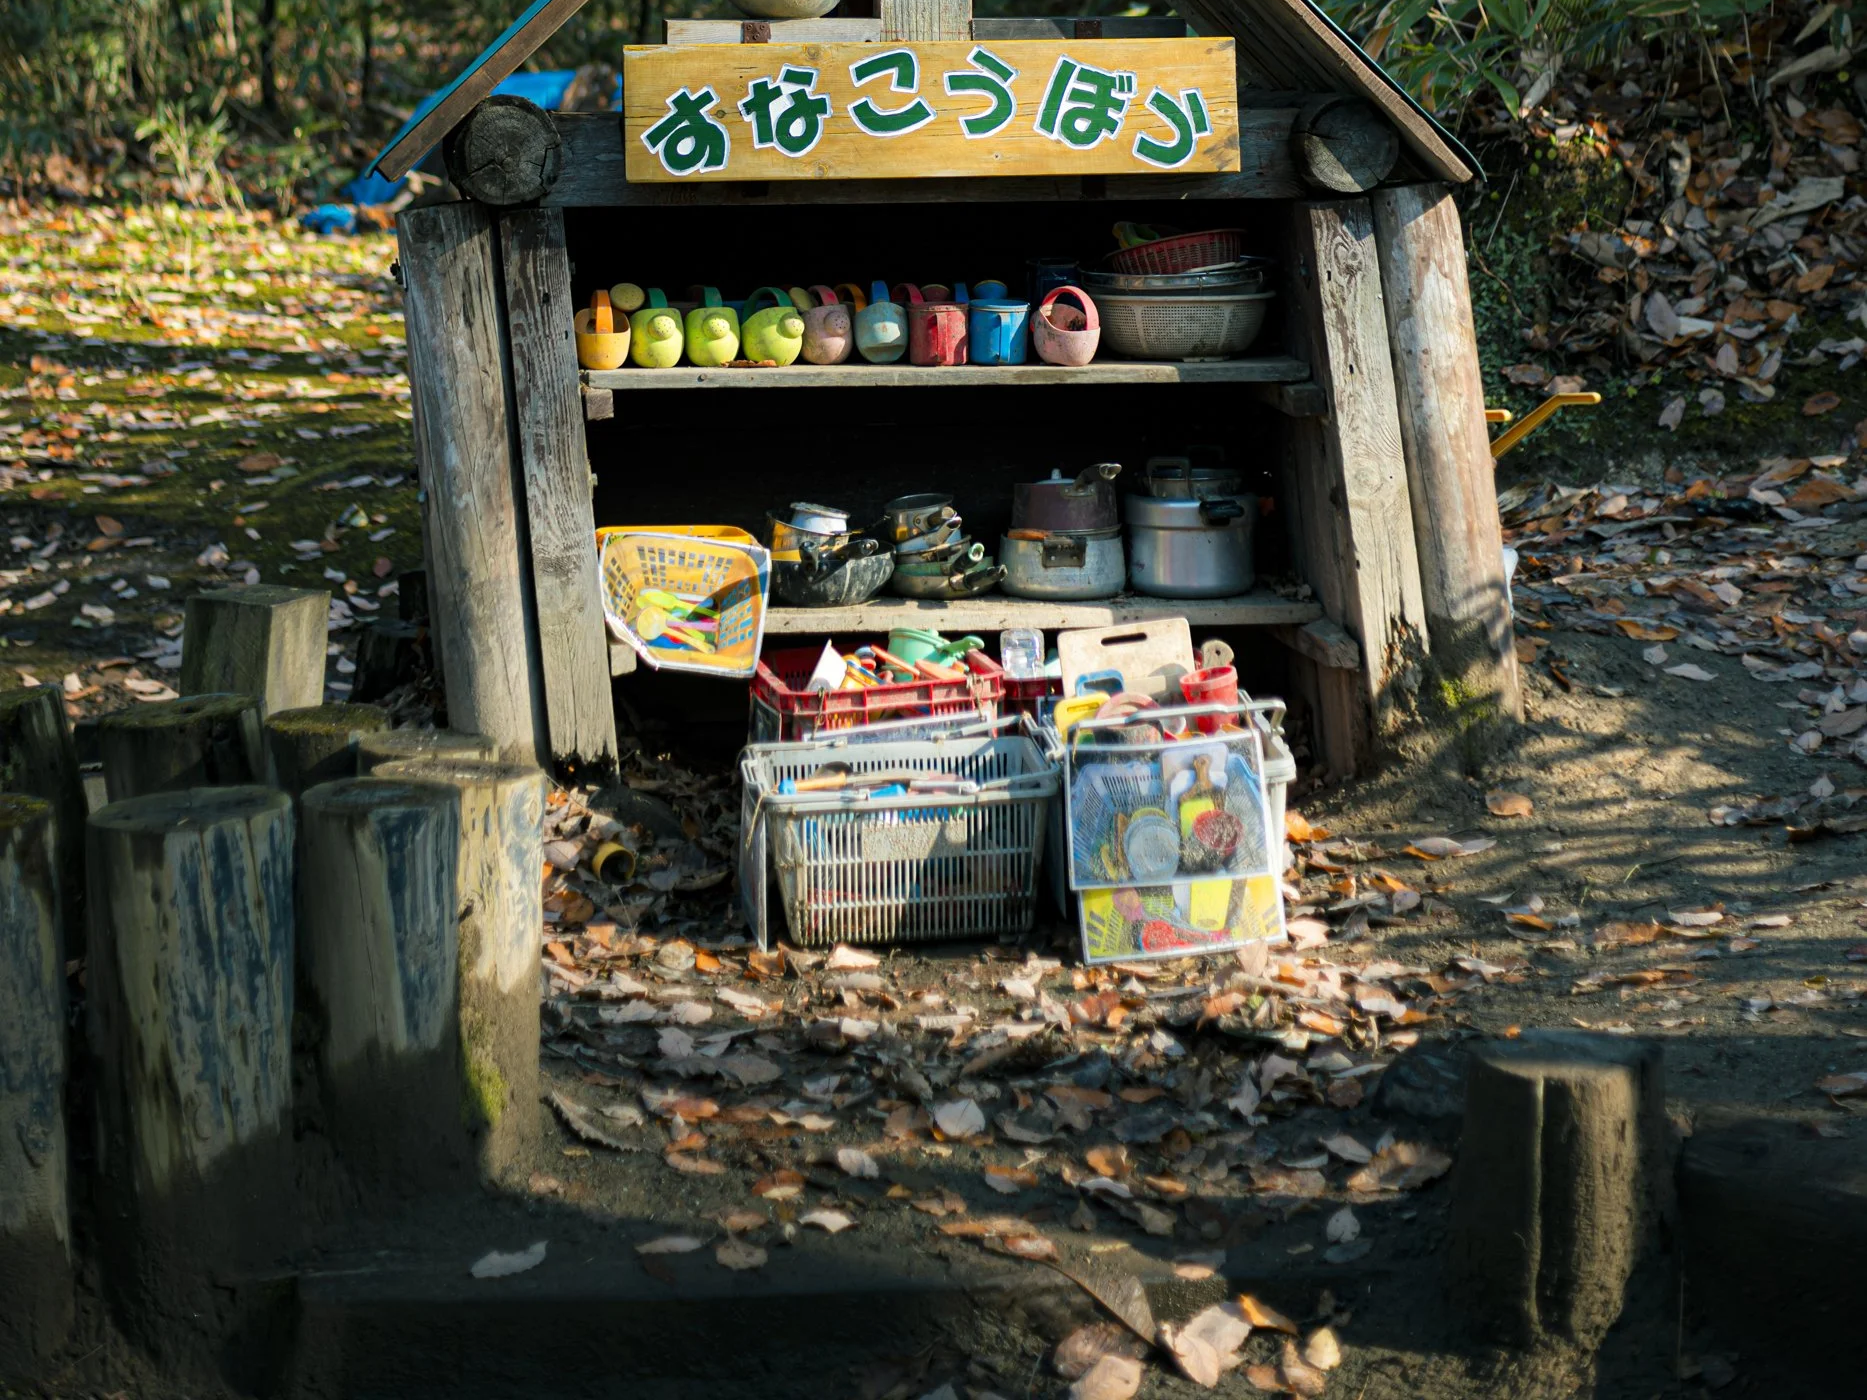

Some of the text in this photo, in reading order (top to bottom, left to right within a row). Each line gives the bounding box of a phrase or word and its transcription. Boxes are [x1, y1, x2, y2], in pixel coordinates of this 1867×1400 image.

[640, 45, 1213, 176] すなこうぼう
